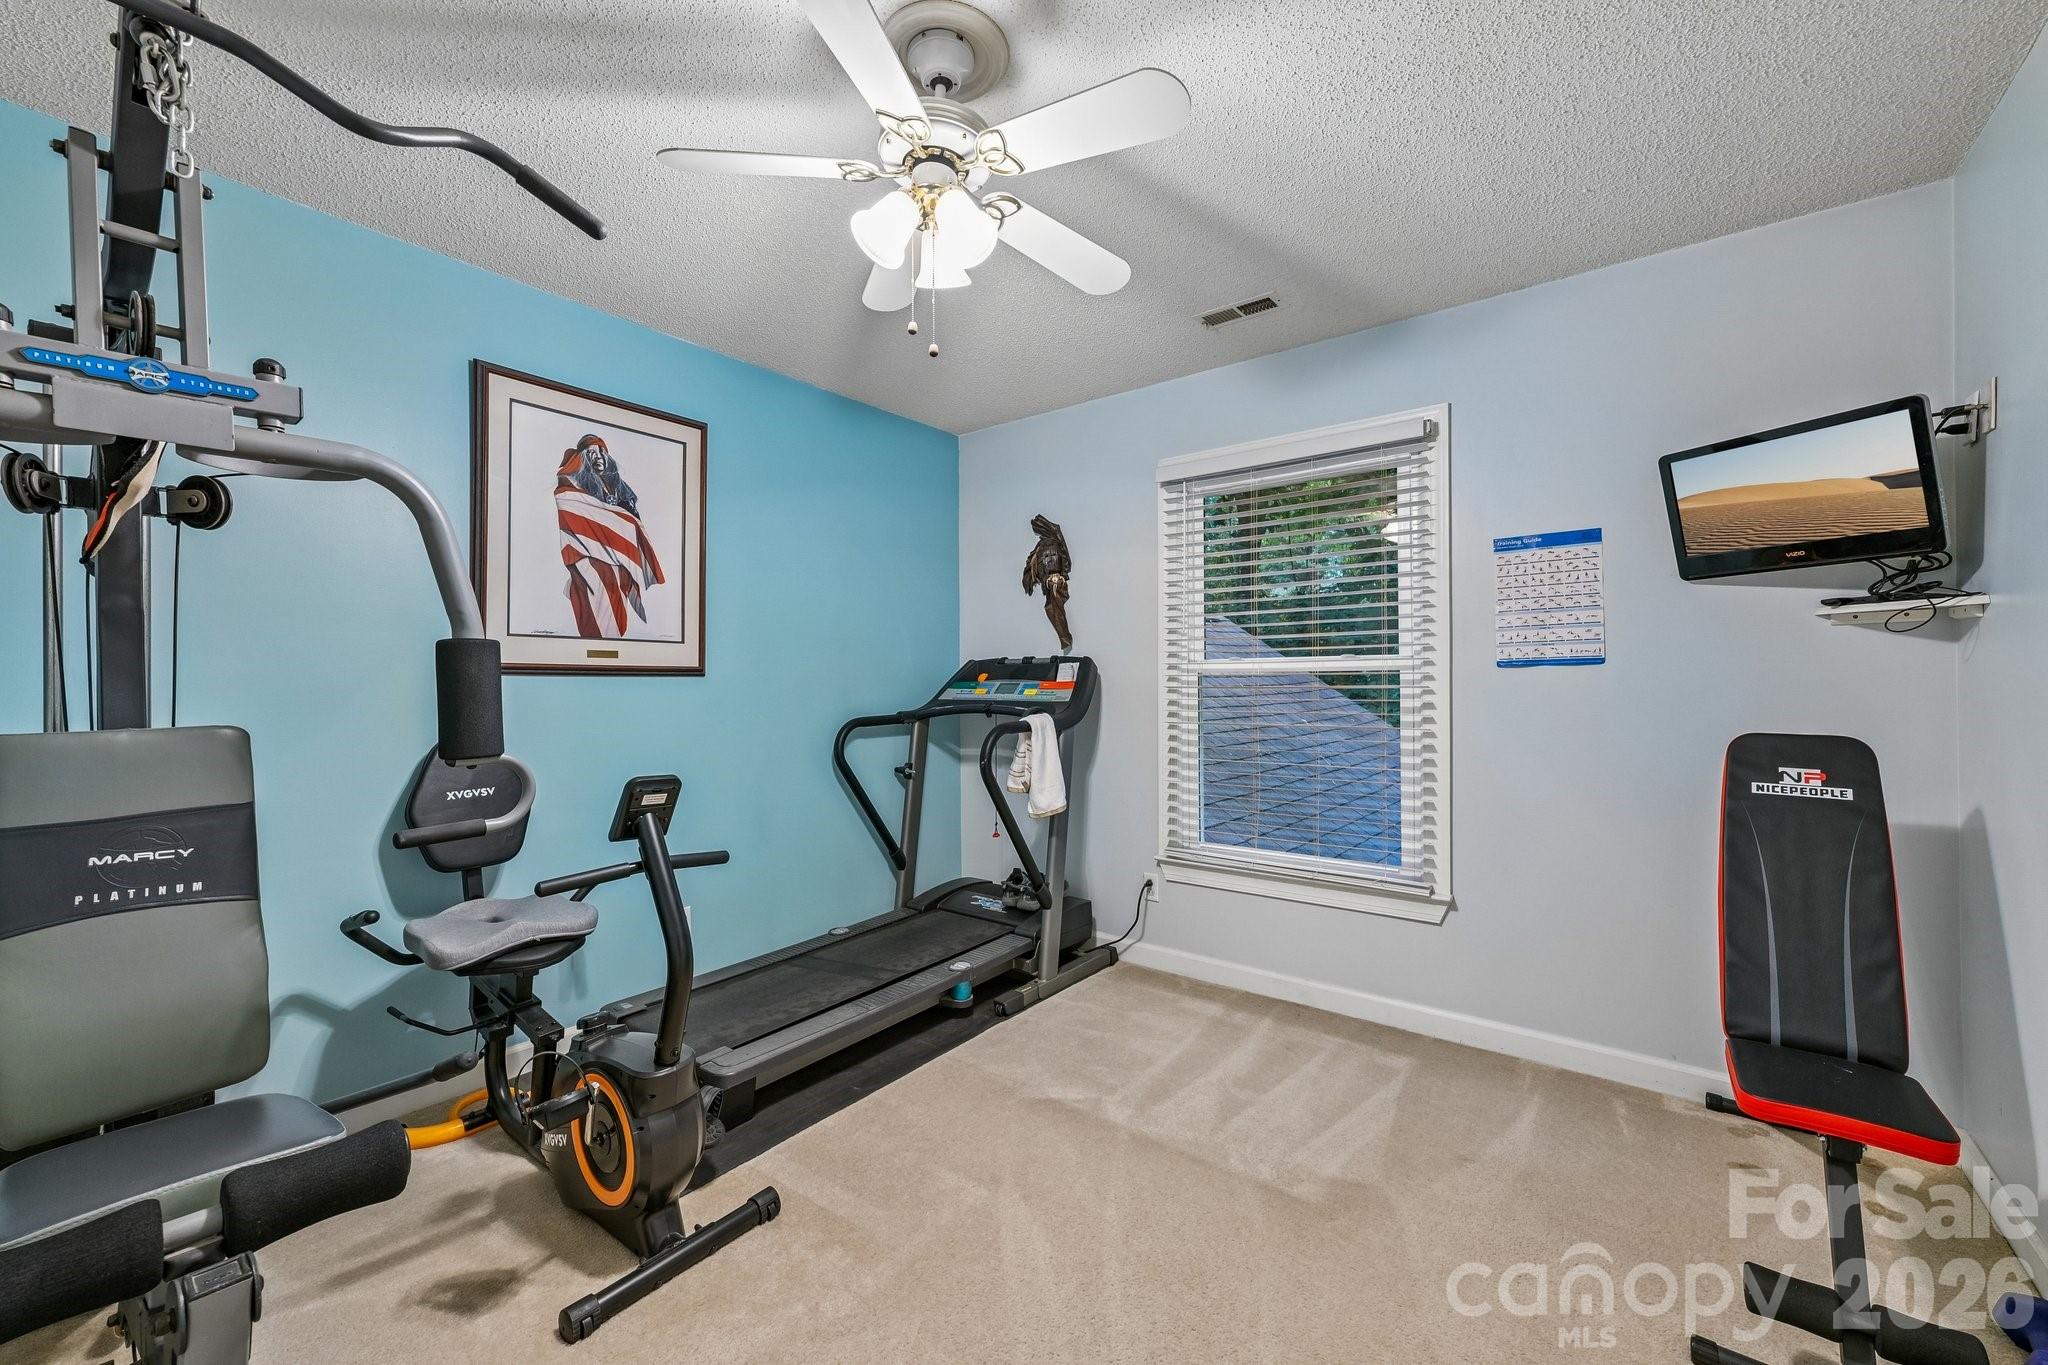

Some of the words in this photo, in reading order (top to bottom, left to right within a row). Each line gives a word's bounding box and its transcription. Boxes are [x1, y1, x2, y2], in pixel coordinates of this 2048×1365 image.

[34, 351, 115, 371] PLATINUM
[446, 786, 495, 800] XVGVSV
[1755, 783, 1849, 799] NICEPEOPLE
[88, 847, 194, 866] MARCY
[74, 881, 203, 905] PLATINUM
